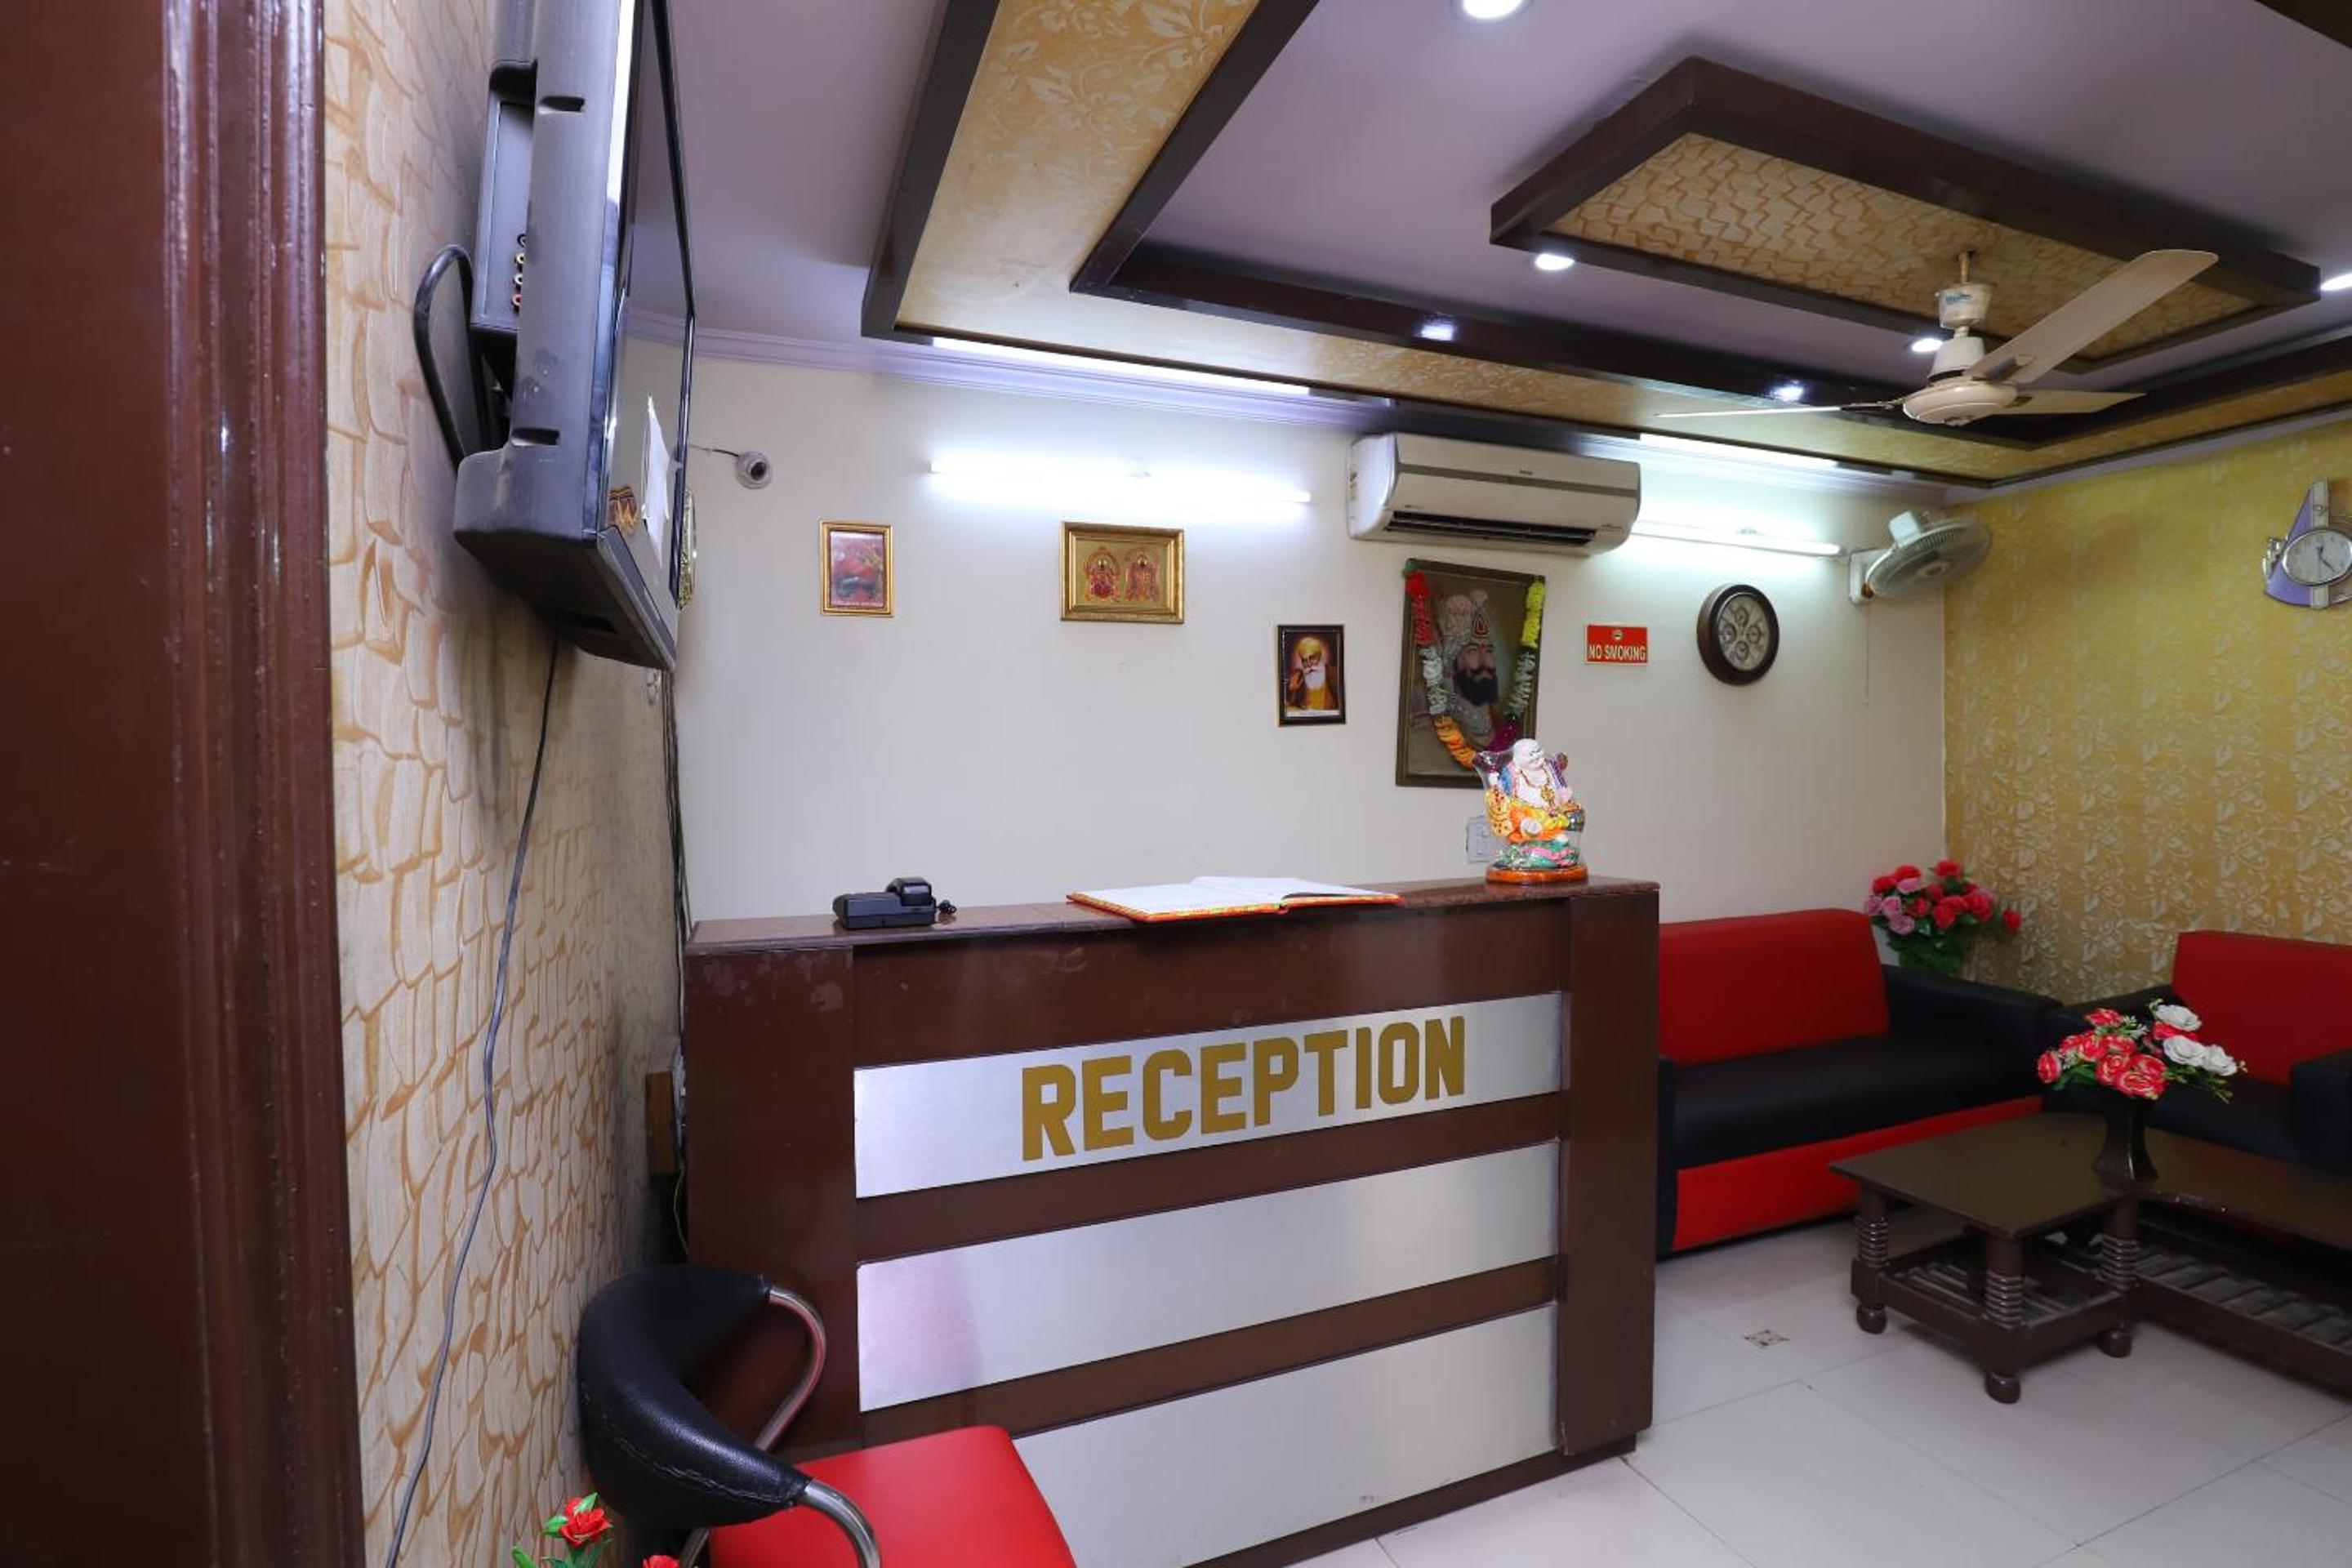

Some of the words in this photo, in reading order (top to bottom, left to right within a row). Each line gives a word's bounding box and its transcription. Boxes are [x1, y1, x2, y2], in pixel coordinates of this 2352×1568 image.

[1589, 644, 1602, 659] NO
[1605, 644, 1646, 662] SMOKING
[1022, 1016, 1465, 1161] RECEPTION
